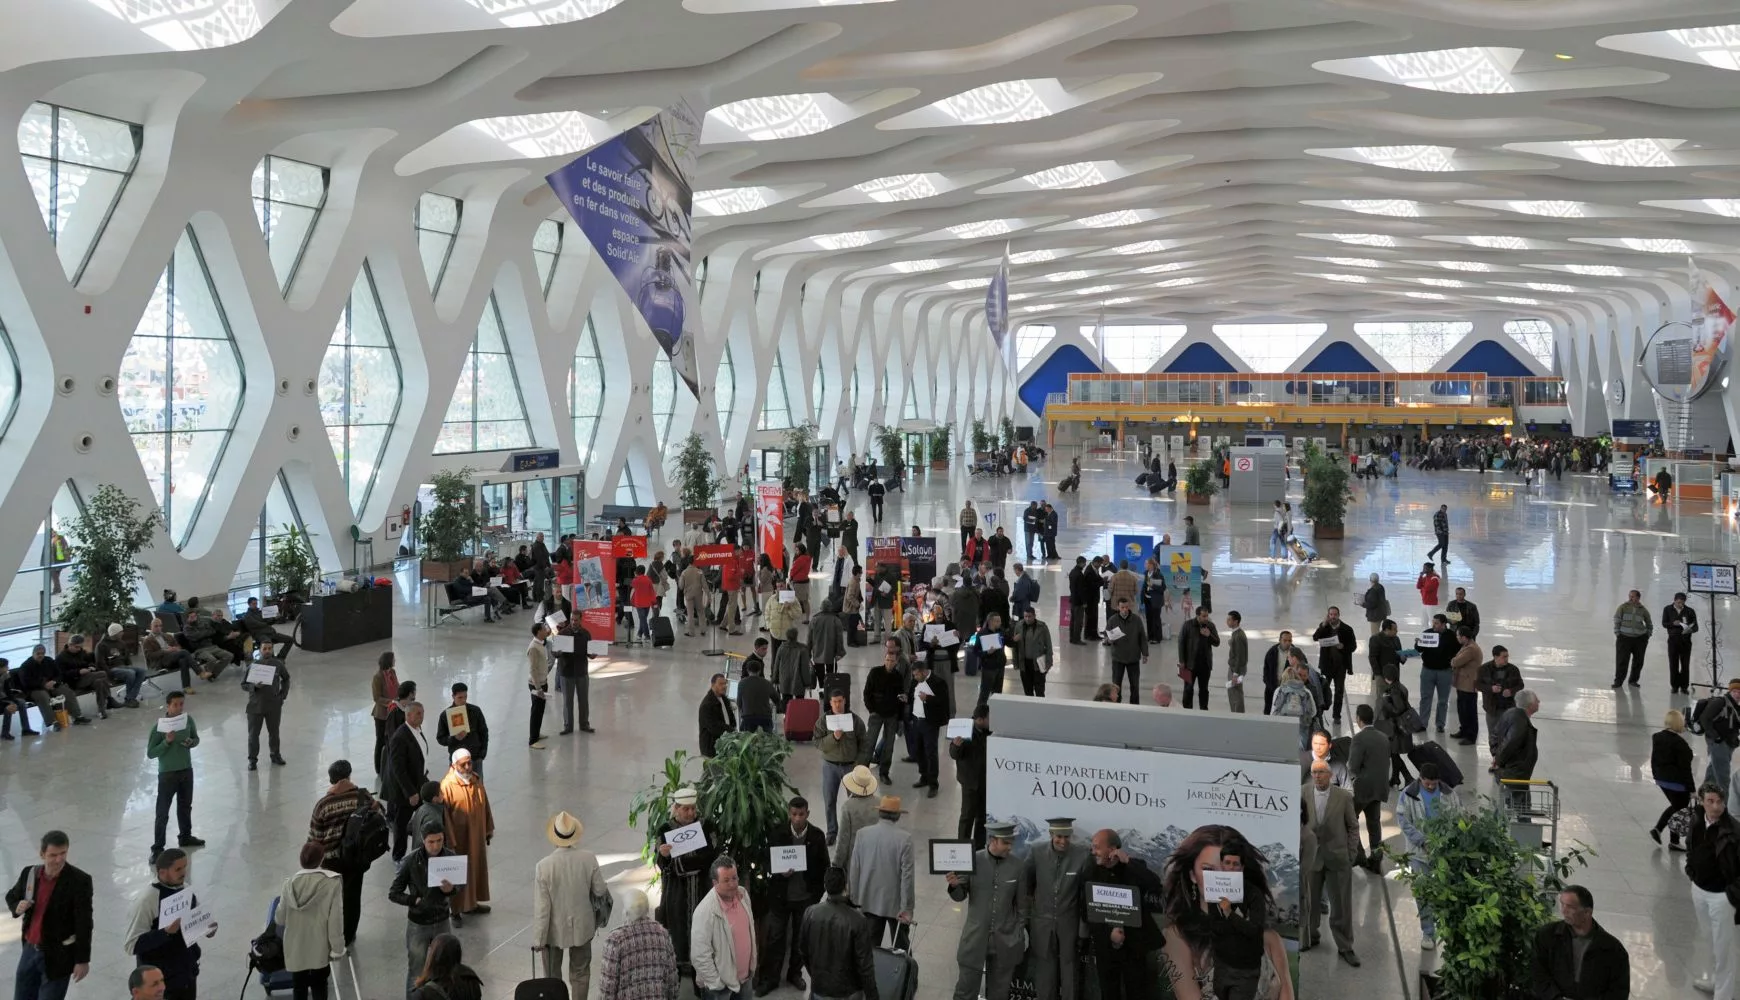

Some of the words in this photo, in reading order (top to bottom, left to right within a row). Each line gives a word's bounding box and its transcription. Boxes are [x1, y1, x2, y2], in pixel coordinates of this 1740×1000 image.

[586, 156, 597, 171] Le
[598, 164, 622, 182] savoir
[624, 173, 641, 191] faire
[582, 177, 591, 189] et
[592, 180, 606, 195] des
[608, 189, 640, 209] produits
[574, 194, 585, 207] en
[586, 196, 598, 211] fer
[599, 203, 618, 220] dans
[620, 212, 640, 226] votre
[612, 228, 640, 245] espace
[1046, 764, 1149, 784] APPARTEMENT
[1031, 776, 1046, 796] À
[1050, 779, 1131, 805] 100.000
[1187, 788, 1226, 801] JARDINS
[1225, 788, 1289, 812] ATLAS
[164, 899, 189, 917] CELIA
